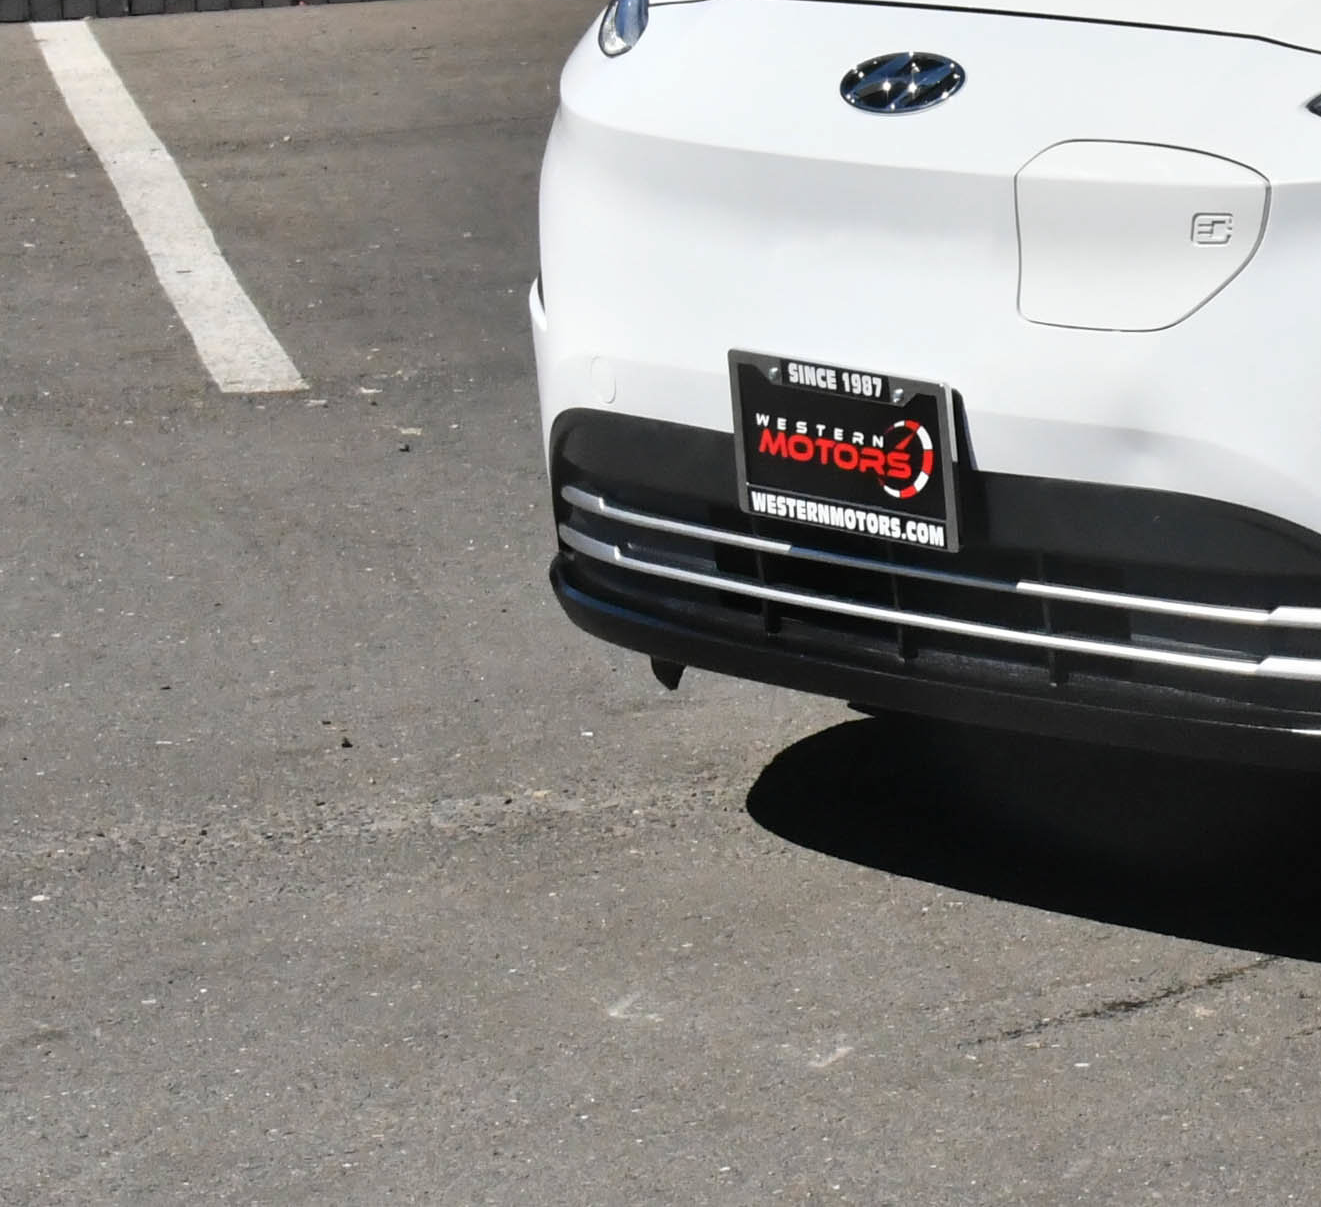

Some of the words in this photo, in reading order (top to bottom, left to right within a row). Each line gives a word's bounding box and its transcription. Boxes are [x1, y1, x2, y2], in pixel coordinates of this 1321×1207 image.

[788, 362, 837, 391] SINCE
[842, 372, 882, 398] 1987
[755, 412, 884, 449] WESTERN
[758, 428, 912, 480] MOTORS
[751, 491, 945, 547] WESTERNMOTORS.COM
